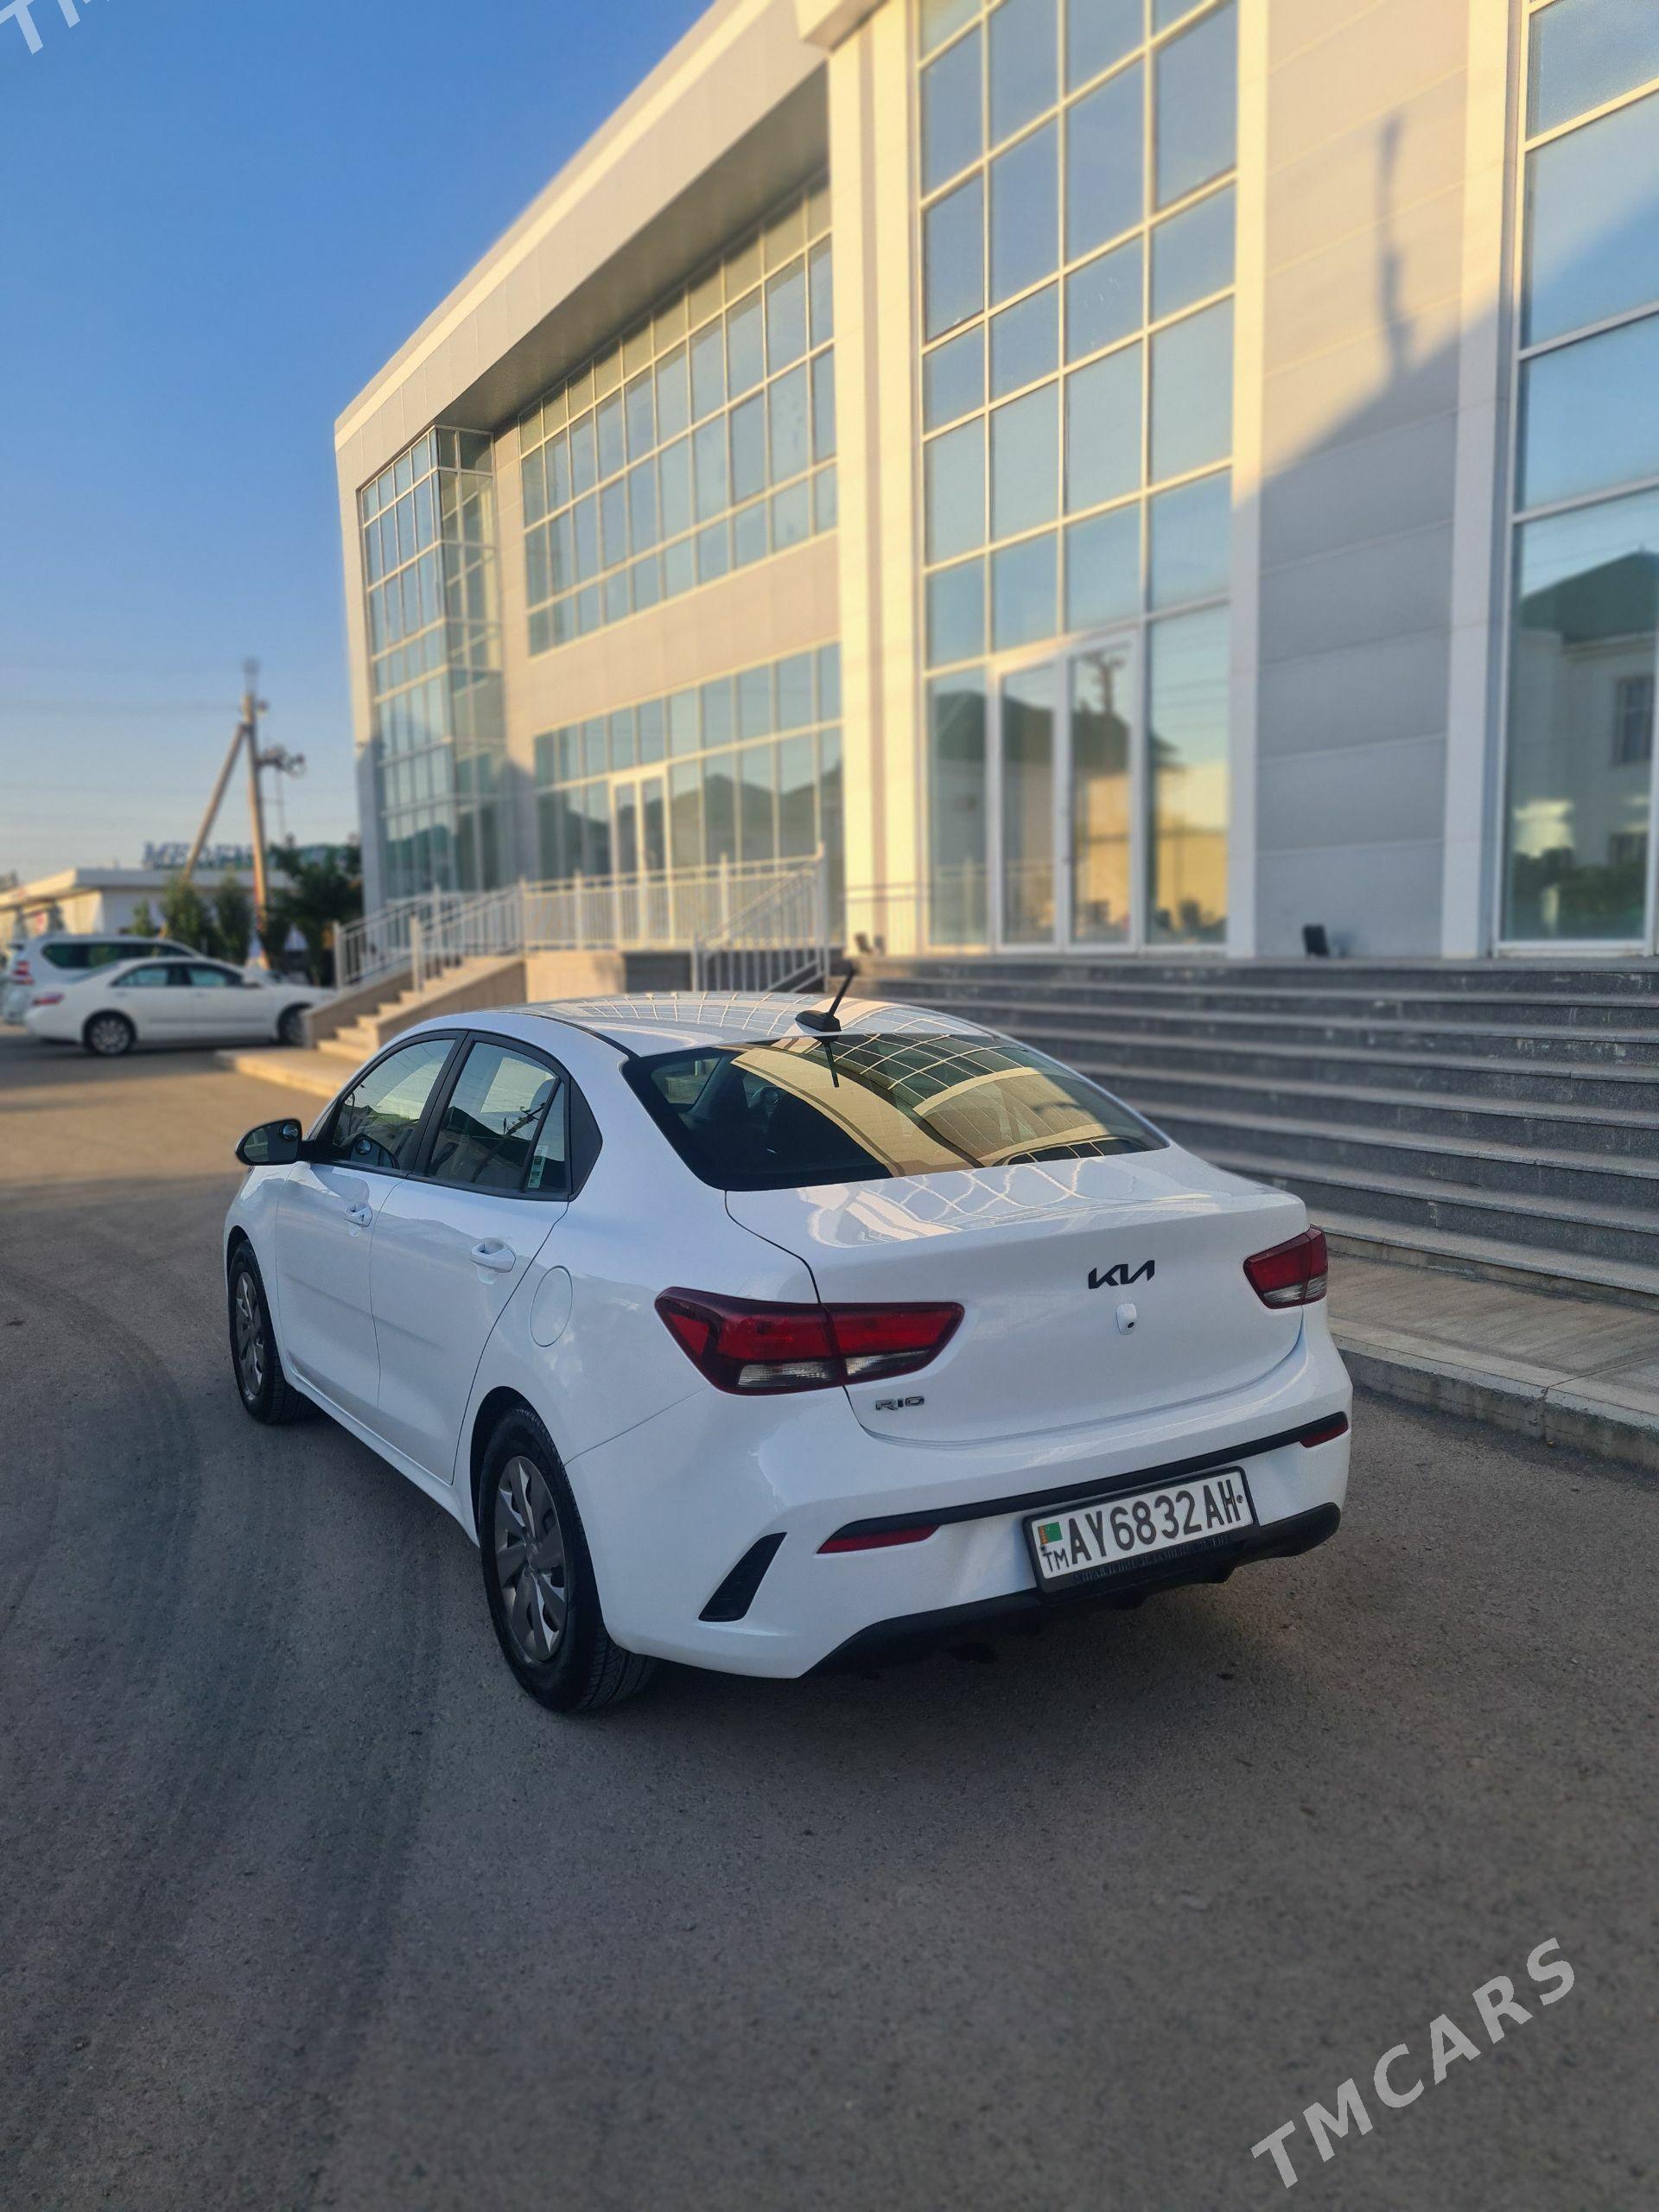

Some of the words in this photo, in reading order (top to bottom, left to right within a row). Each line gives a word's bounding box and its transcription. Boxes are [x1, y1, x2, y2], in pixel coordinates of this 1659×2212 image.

[1088, 1260, 1155, 1289] KIA
[875, 1395, 925, 1411] RIO
[1068, 1479, 1241, 1565] AY6832AH
[1042, 1548, 1070, 1573] TM
